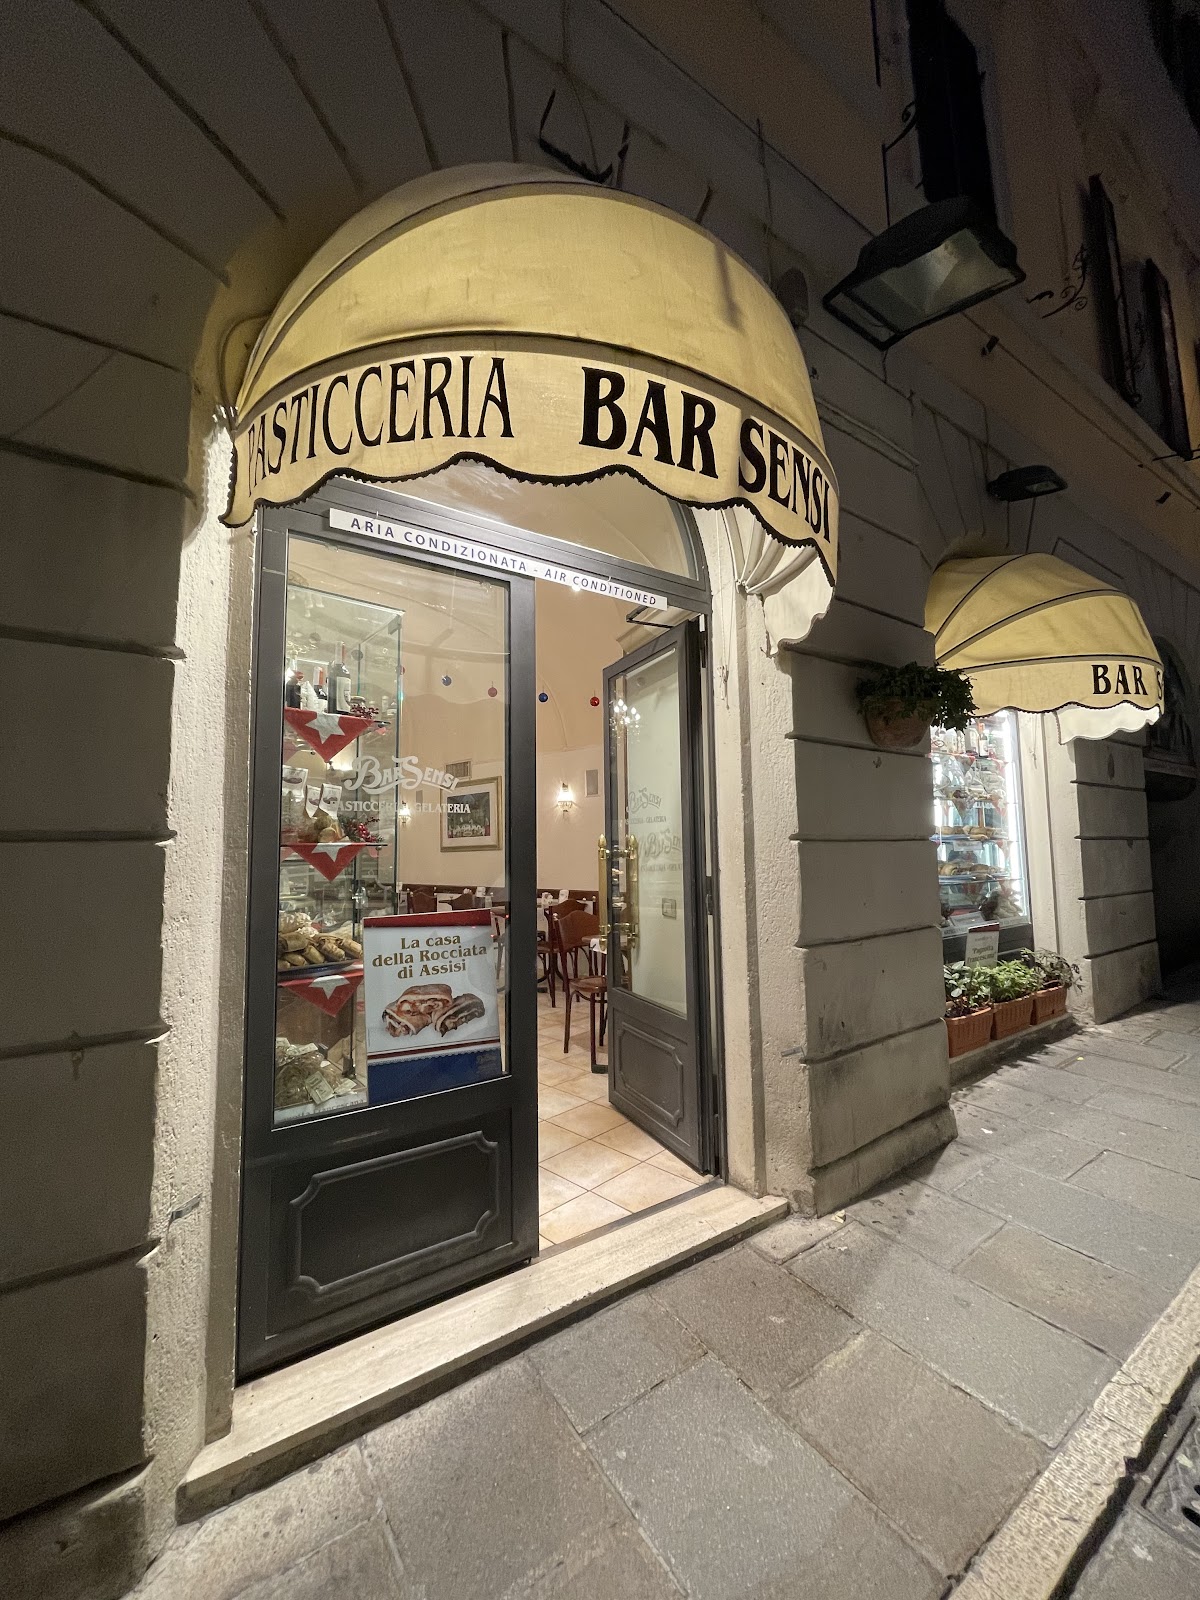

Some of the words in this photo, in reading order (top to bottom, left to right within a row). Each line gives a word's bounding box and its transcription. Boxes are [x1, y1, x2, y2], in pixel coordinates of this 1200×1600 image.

[248, 356, 515, 497] PASTICCERIA
[578, 366, 719, 479] BAR
[738, 418, 831, 543] SENSI
[351, 517, 395, 538] ARIA
[404, 531, 527, 572] CONDIZIONATA
[544, 568, 567, 583] AIR
[573, 575, 656, 606] CONDITIONED
[1091, 664, 1149, 696] BAR
[415, 802, 471, 814] GELATERIA
[400, 937, 420, 950] La
[425, 935, 462, 947] casa
[371, 952, 414, 968] della
[419, 945, 488, 963] Rocciata
[397, 965, 414, 980] di
[419, 958, 467, 977] Assisi
